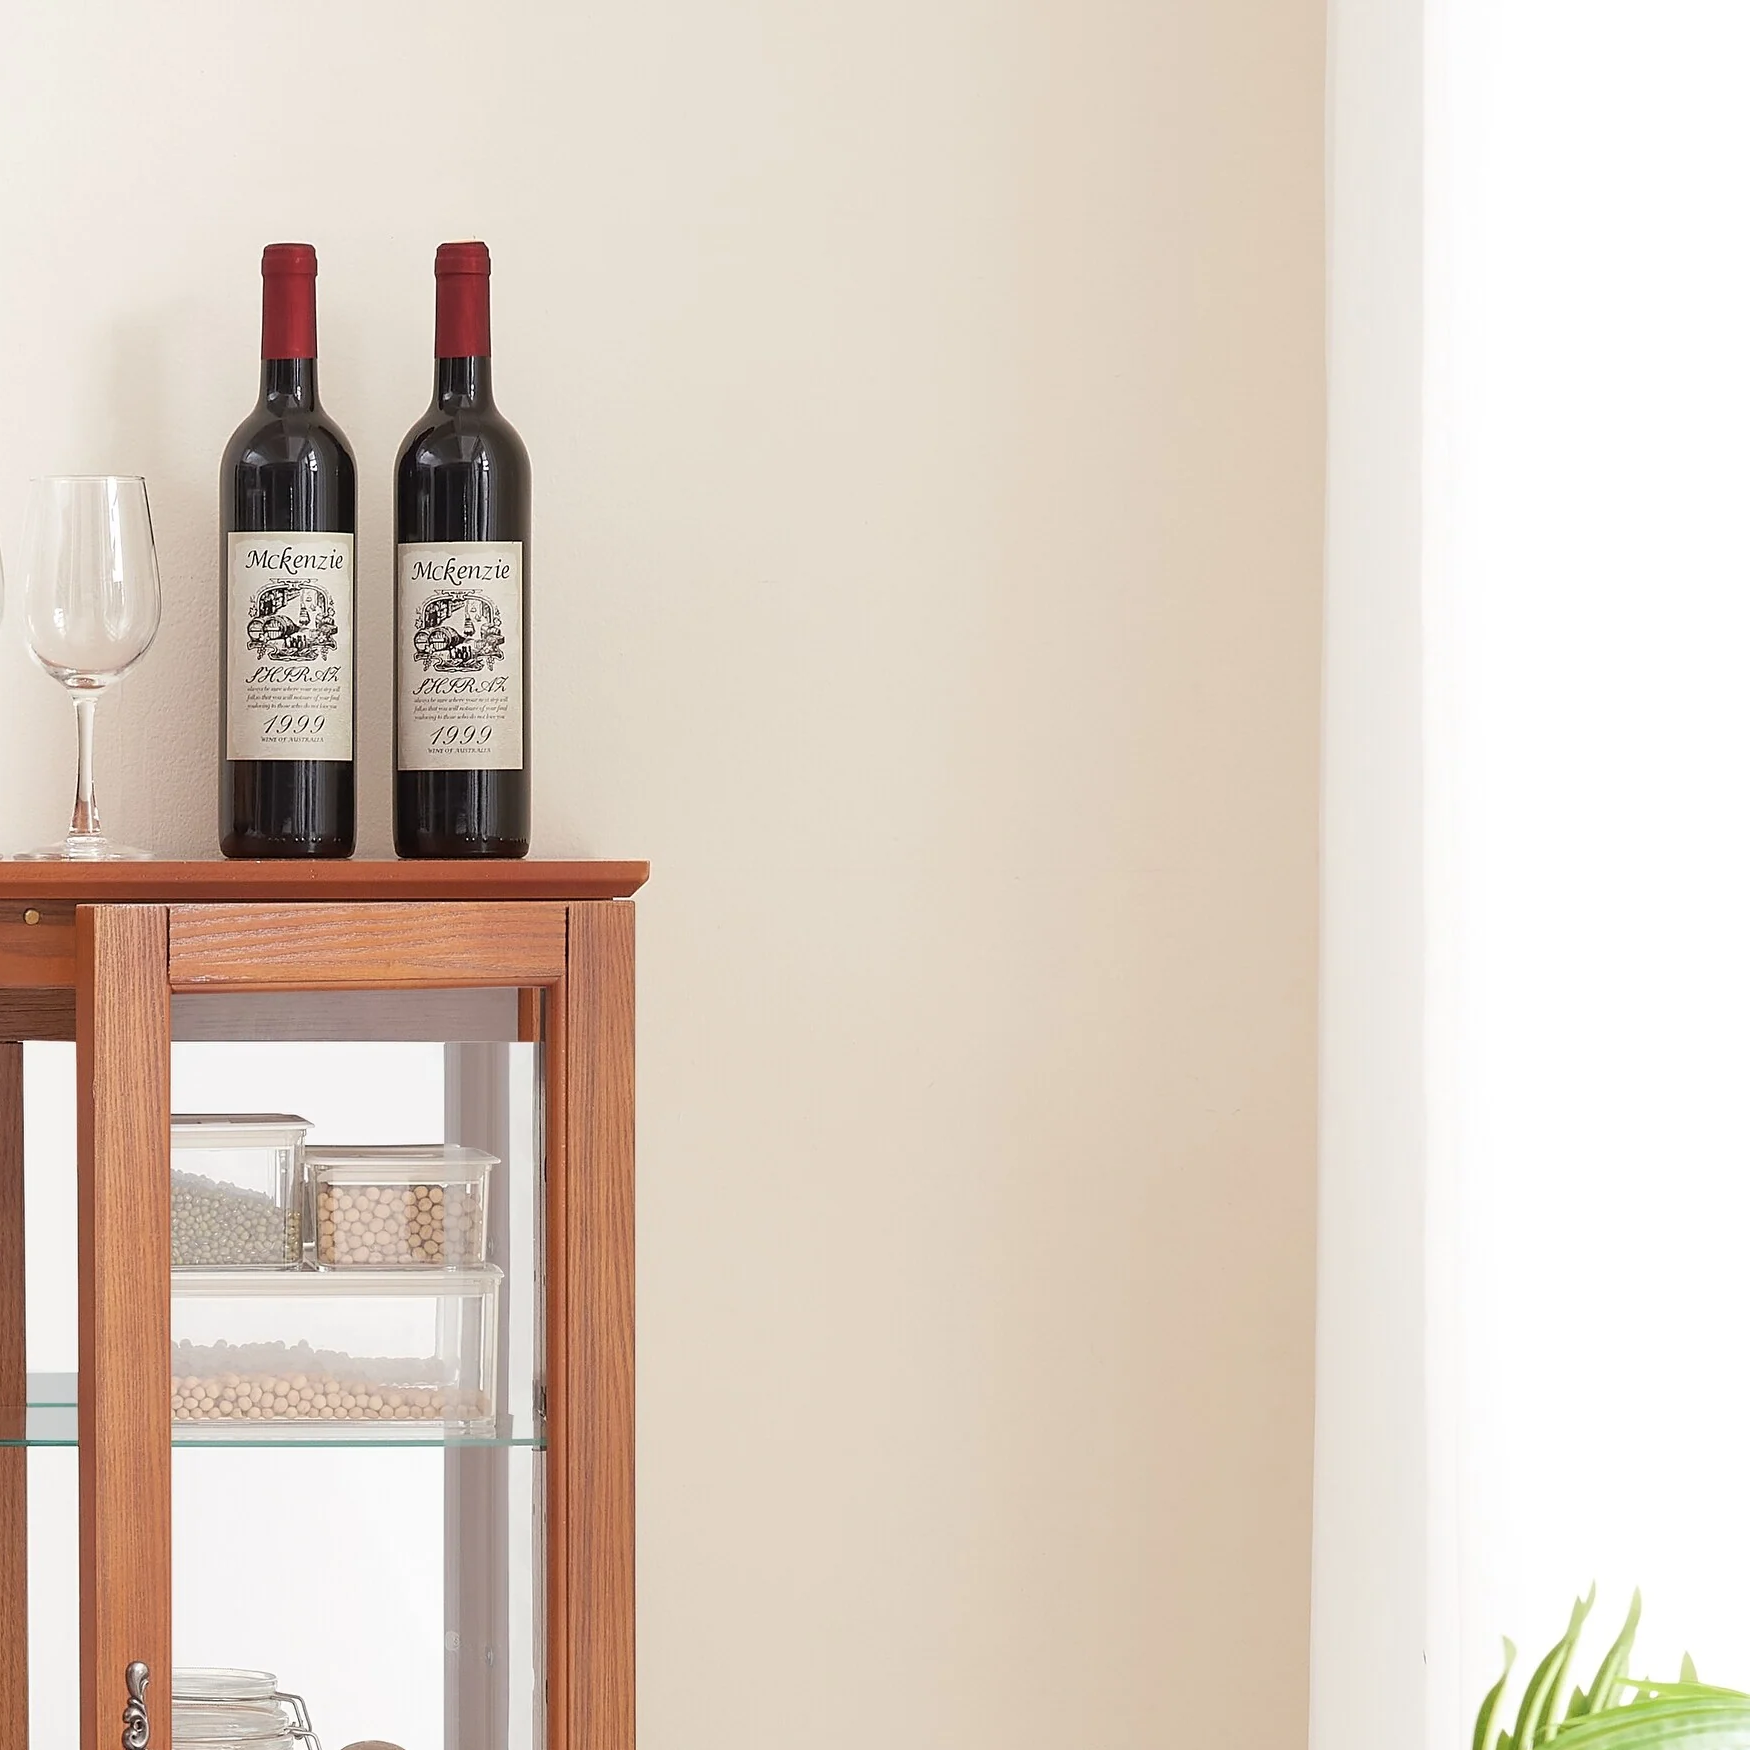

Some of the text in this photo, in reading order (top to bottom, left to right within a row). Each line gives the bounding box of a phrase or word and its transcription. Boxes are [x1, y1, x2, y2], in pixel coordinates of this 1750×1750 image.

[245, 546, 344, 575] Mckenzie
[411, 557, 510, 586] Mckenzie
[263, 714, 325, 734] 1999
[430, 725, 492, 745] 1999
